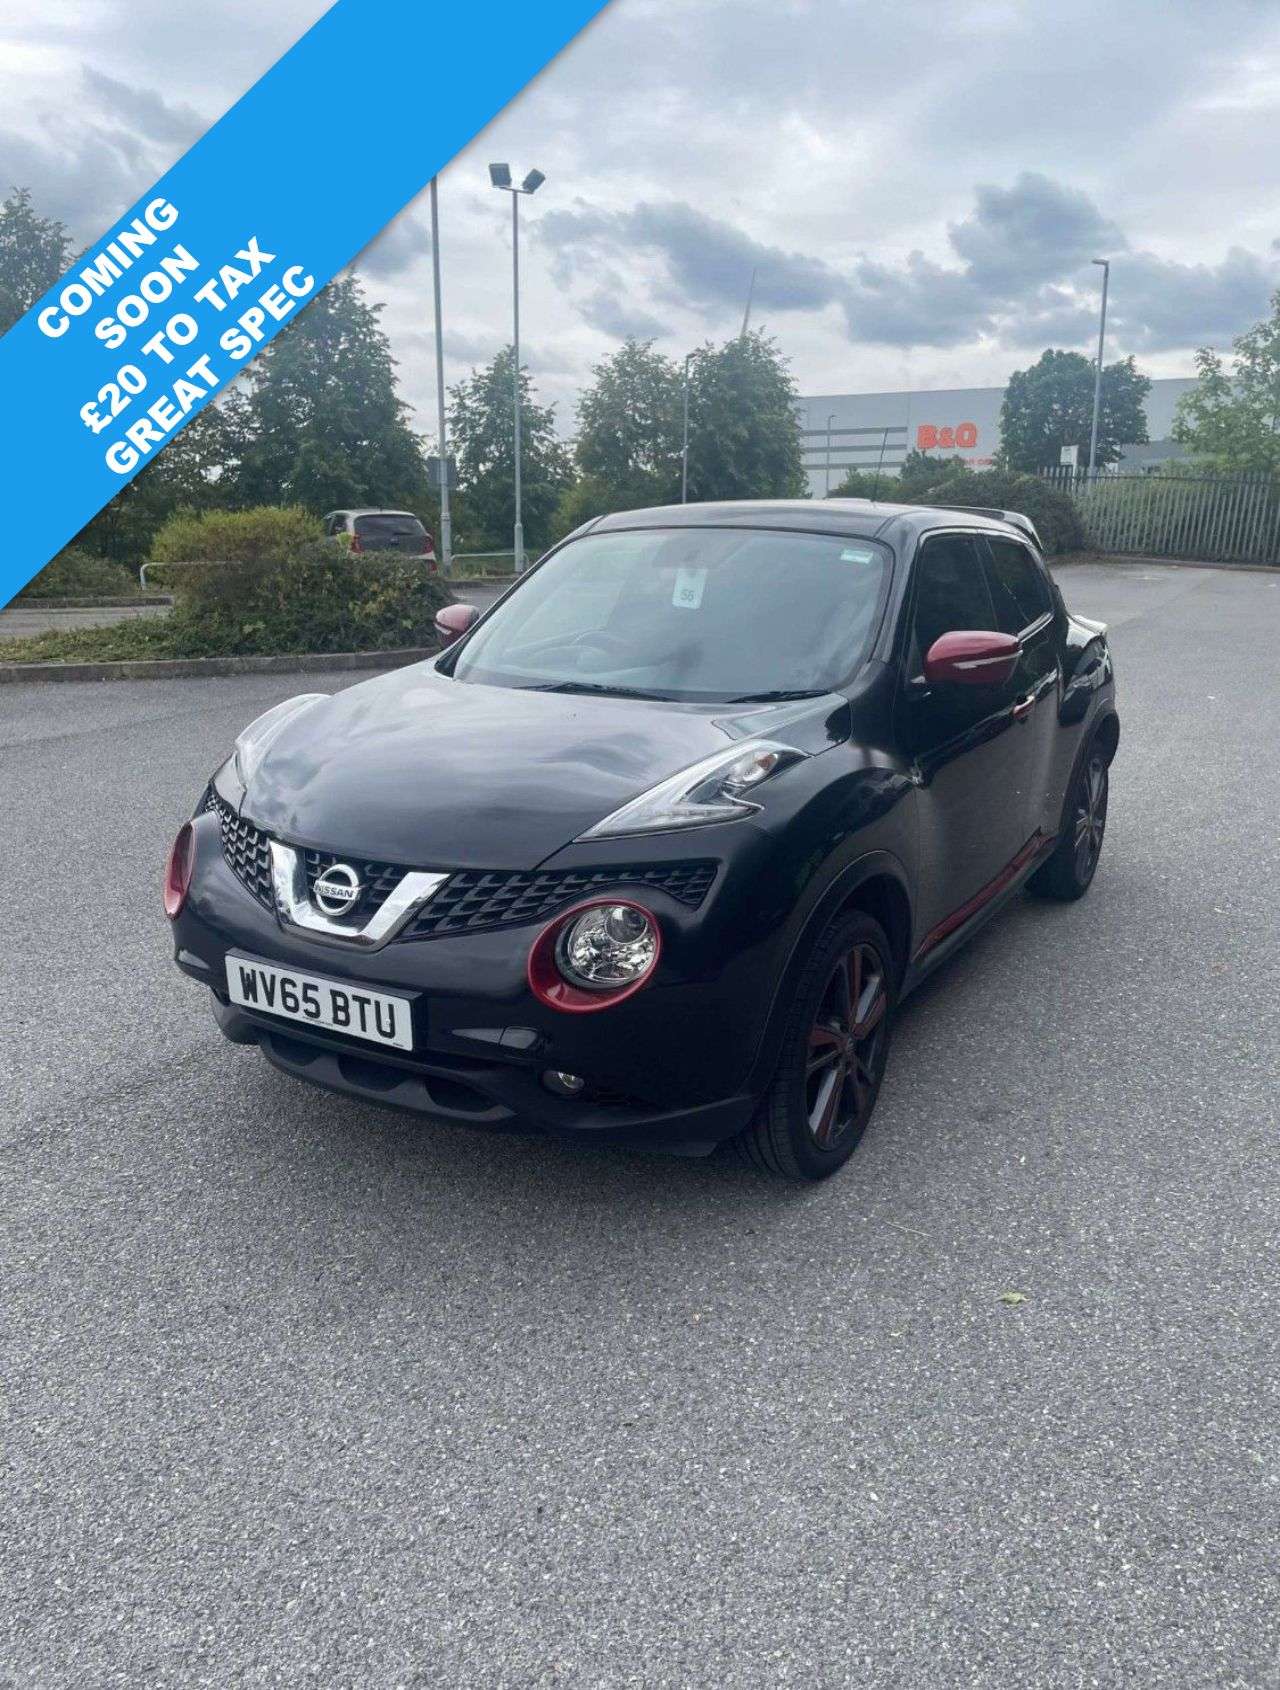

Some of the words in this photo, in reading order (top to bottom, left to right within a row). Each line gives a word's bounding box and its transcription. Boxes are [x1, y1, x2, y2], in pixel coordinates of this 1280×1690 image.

[917, 422, 977, 449] B&Q
[239, 966, 321, 1019] WV65
[329, 989, 396, 1039] BTU
